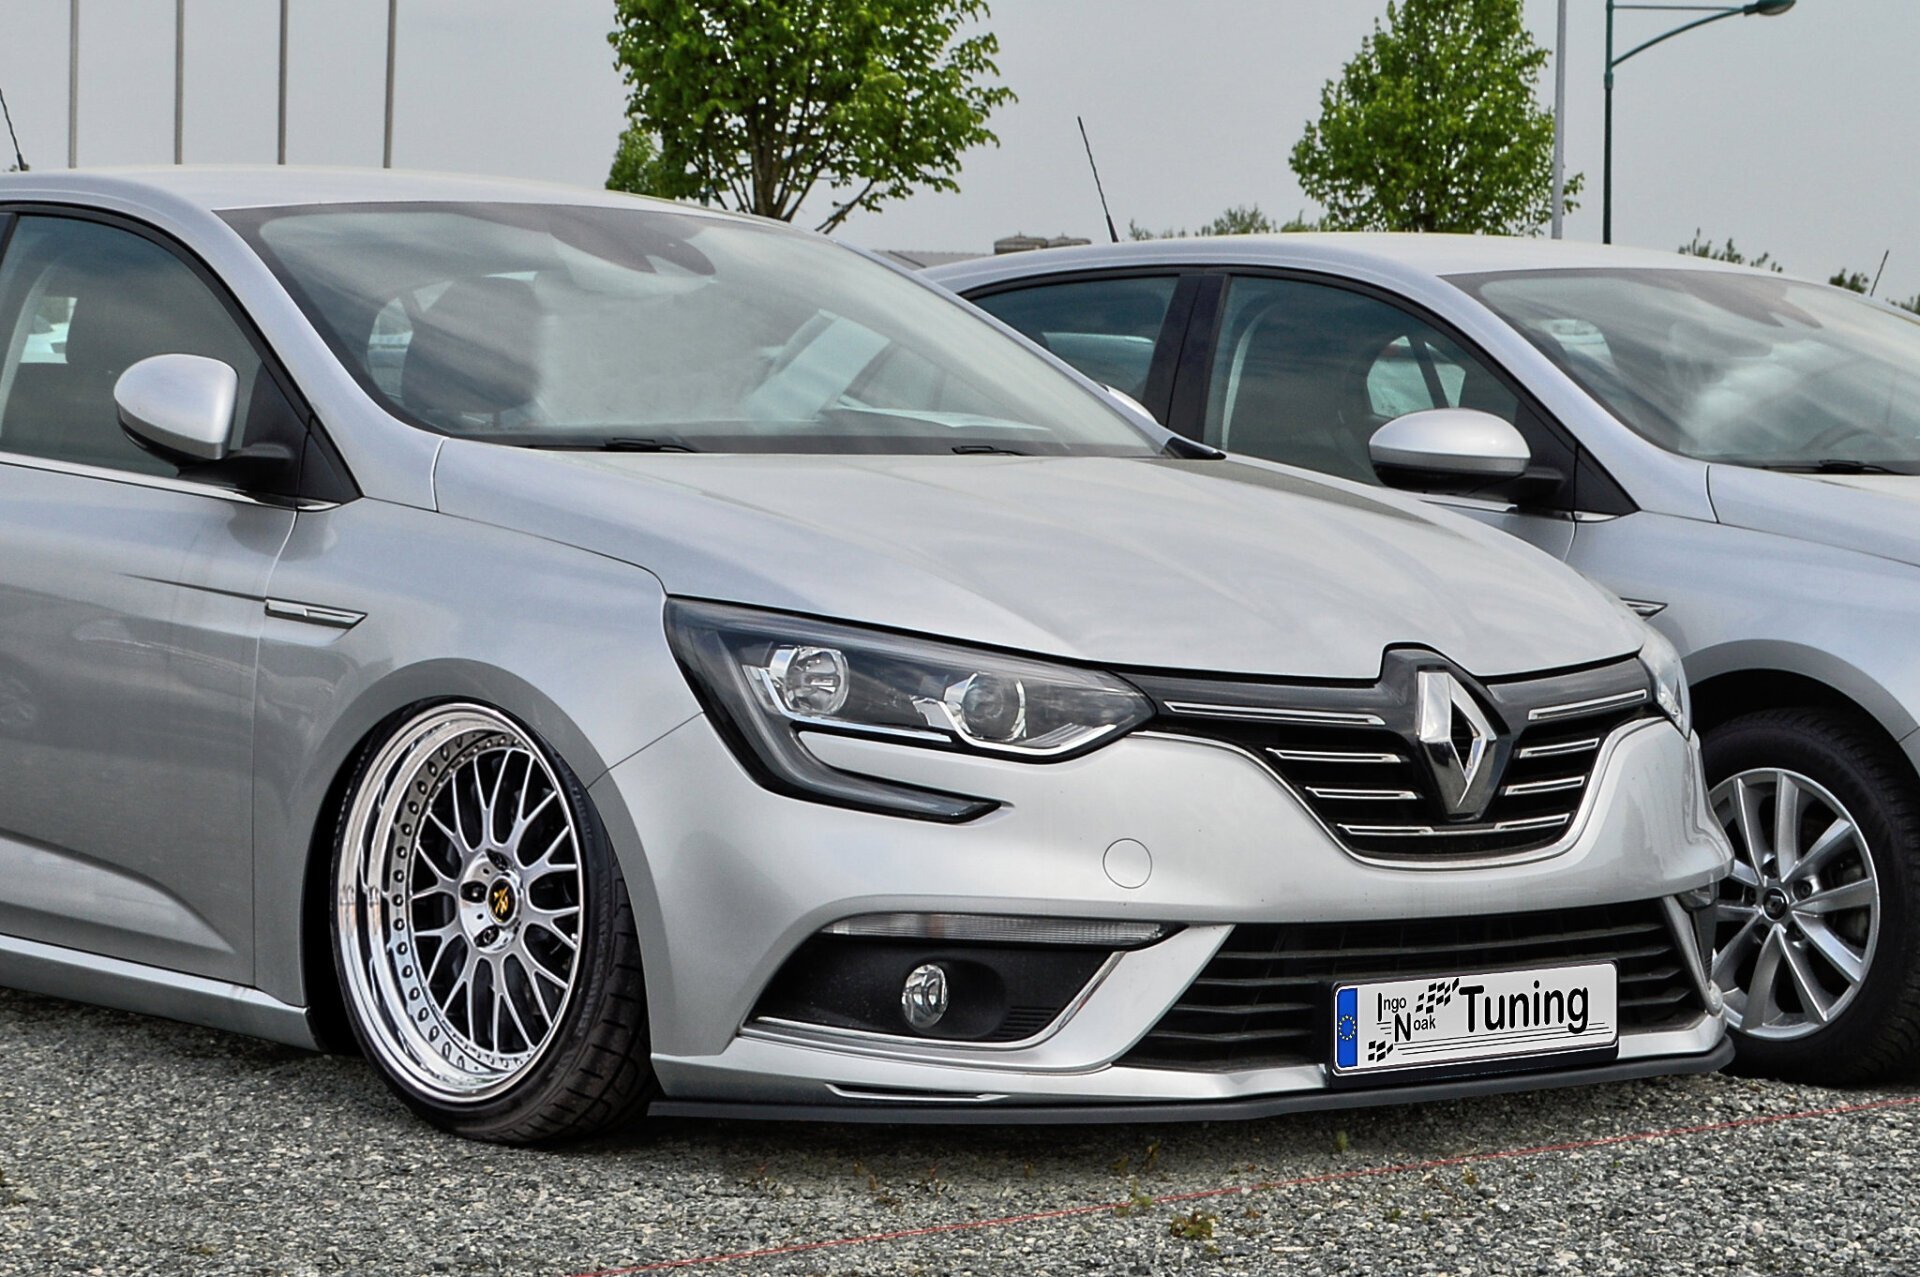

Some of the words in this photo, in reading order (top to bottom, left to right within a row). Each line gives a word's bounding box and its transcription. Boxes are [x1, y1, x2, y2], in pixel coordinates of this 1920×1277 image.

[1377, 993, 1407, 1022] Ingo
[1459, 980, 1589, 1034] Tuning
[1394, 1012, 1437, 1043] Noak
